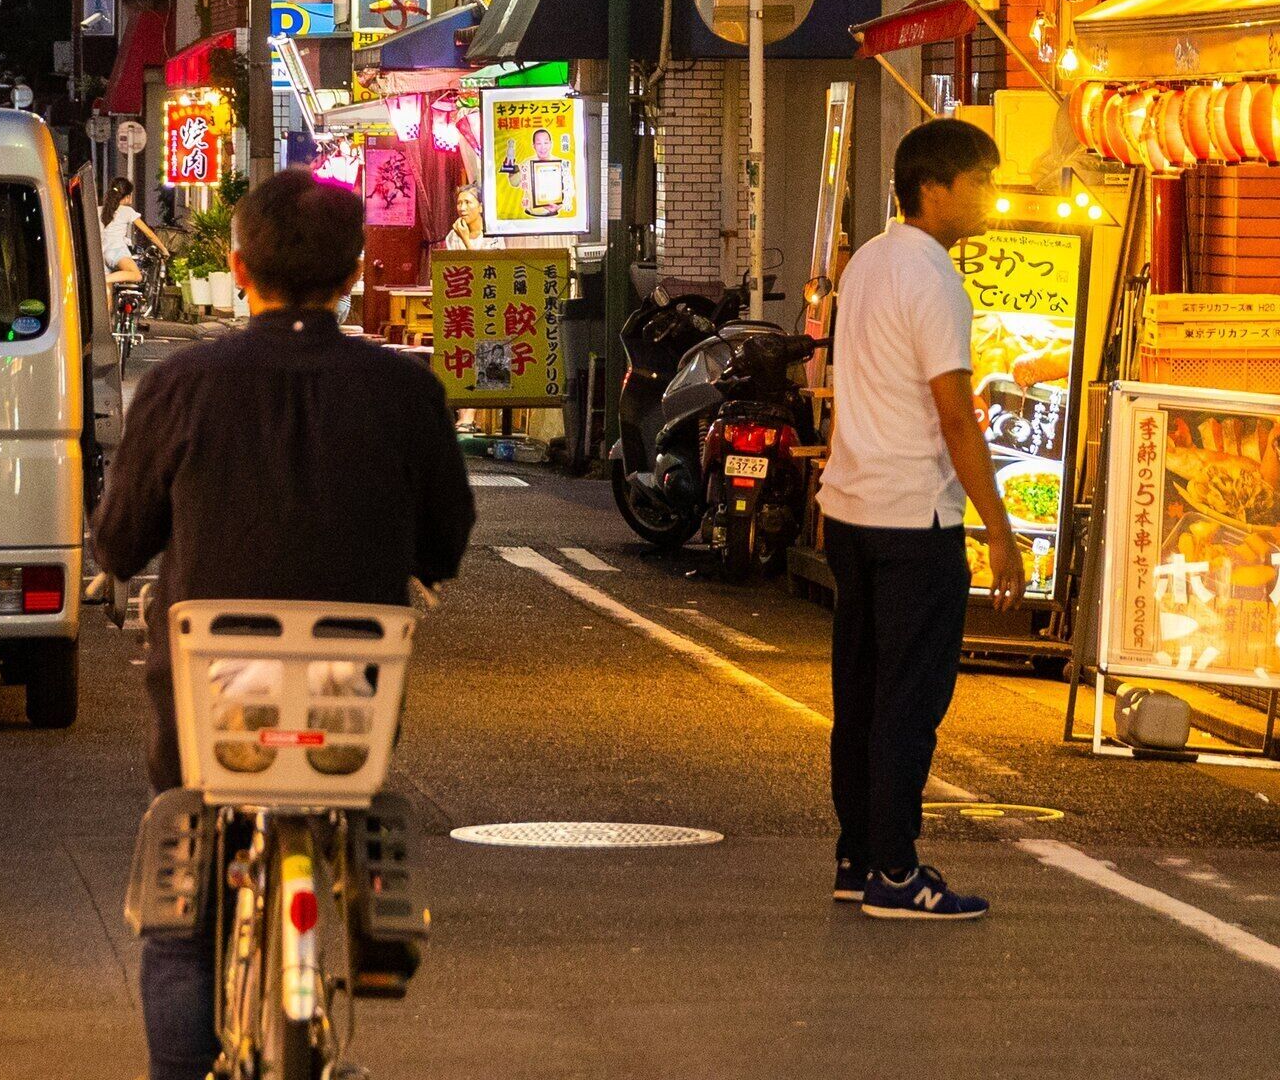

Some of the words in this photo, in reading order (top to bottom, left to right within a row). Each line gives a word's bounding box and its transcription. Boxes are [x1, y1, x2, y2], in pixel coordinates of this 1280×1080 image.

[496, 102, 572, 116] キタナシュラン
[181, 117, 209, 179] 焼肉
[513, 265, 528, 295] 三陽
[949, 237, 1055, 278] 串かつ
[442, 265, 476, 380] 営業中
[482, 265, 498, 336] 本店そこ
[543, 263, 560, 397] 毛沢東もビックリの
[503, 302, 538, 377] 餃子
[913, 886, 943, 910] N
